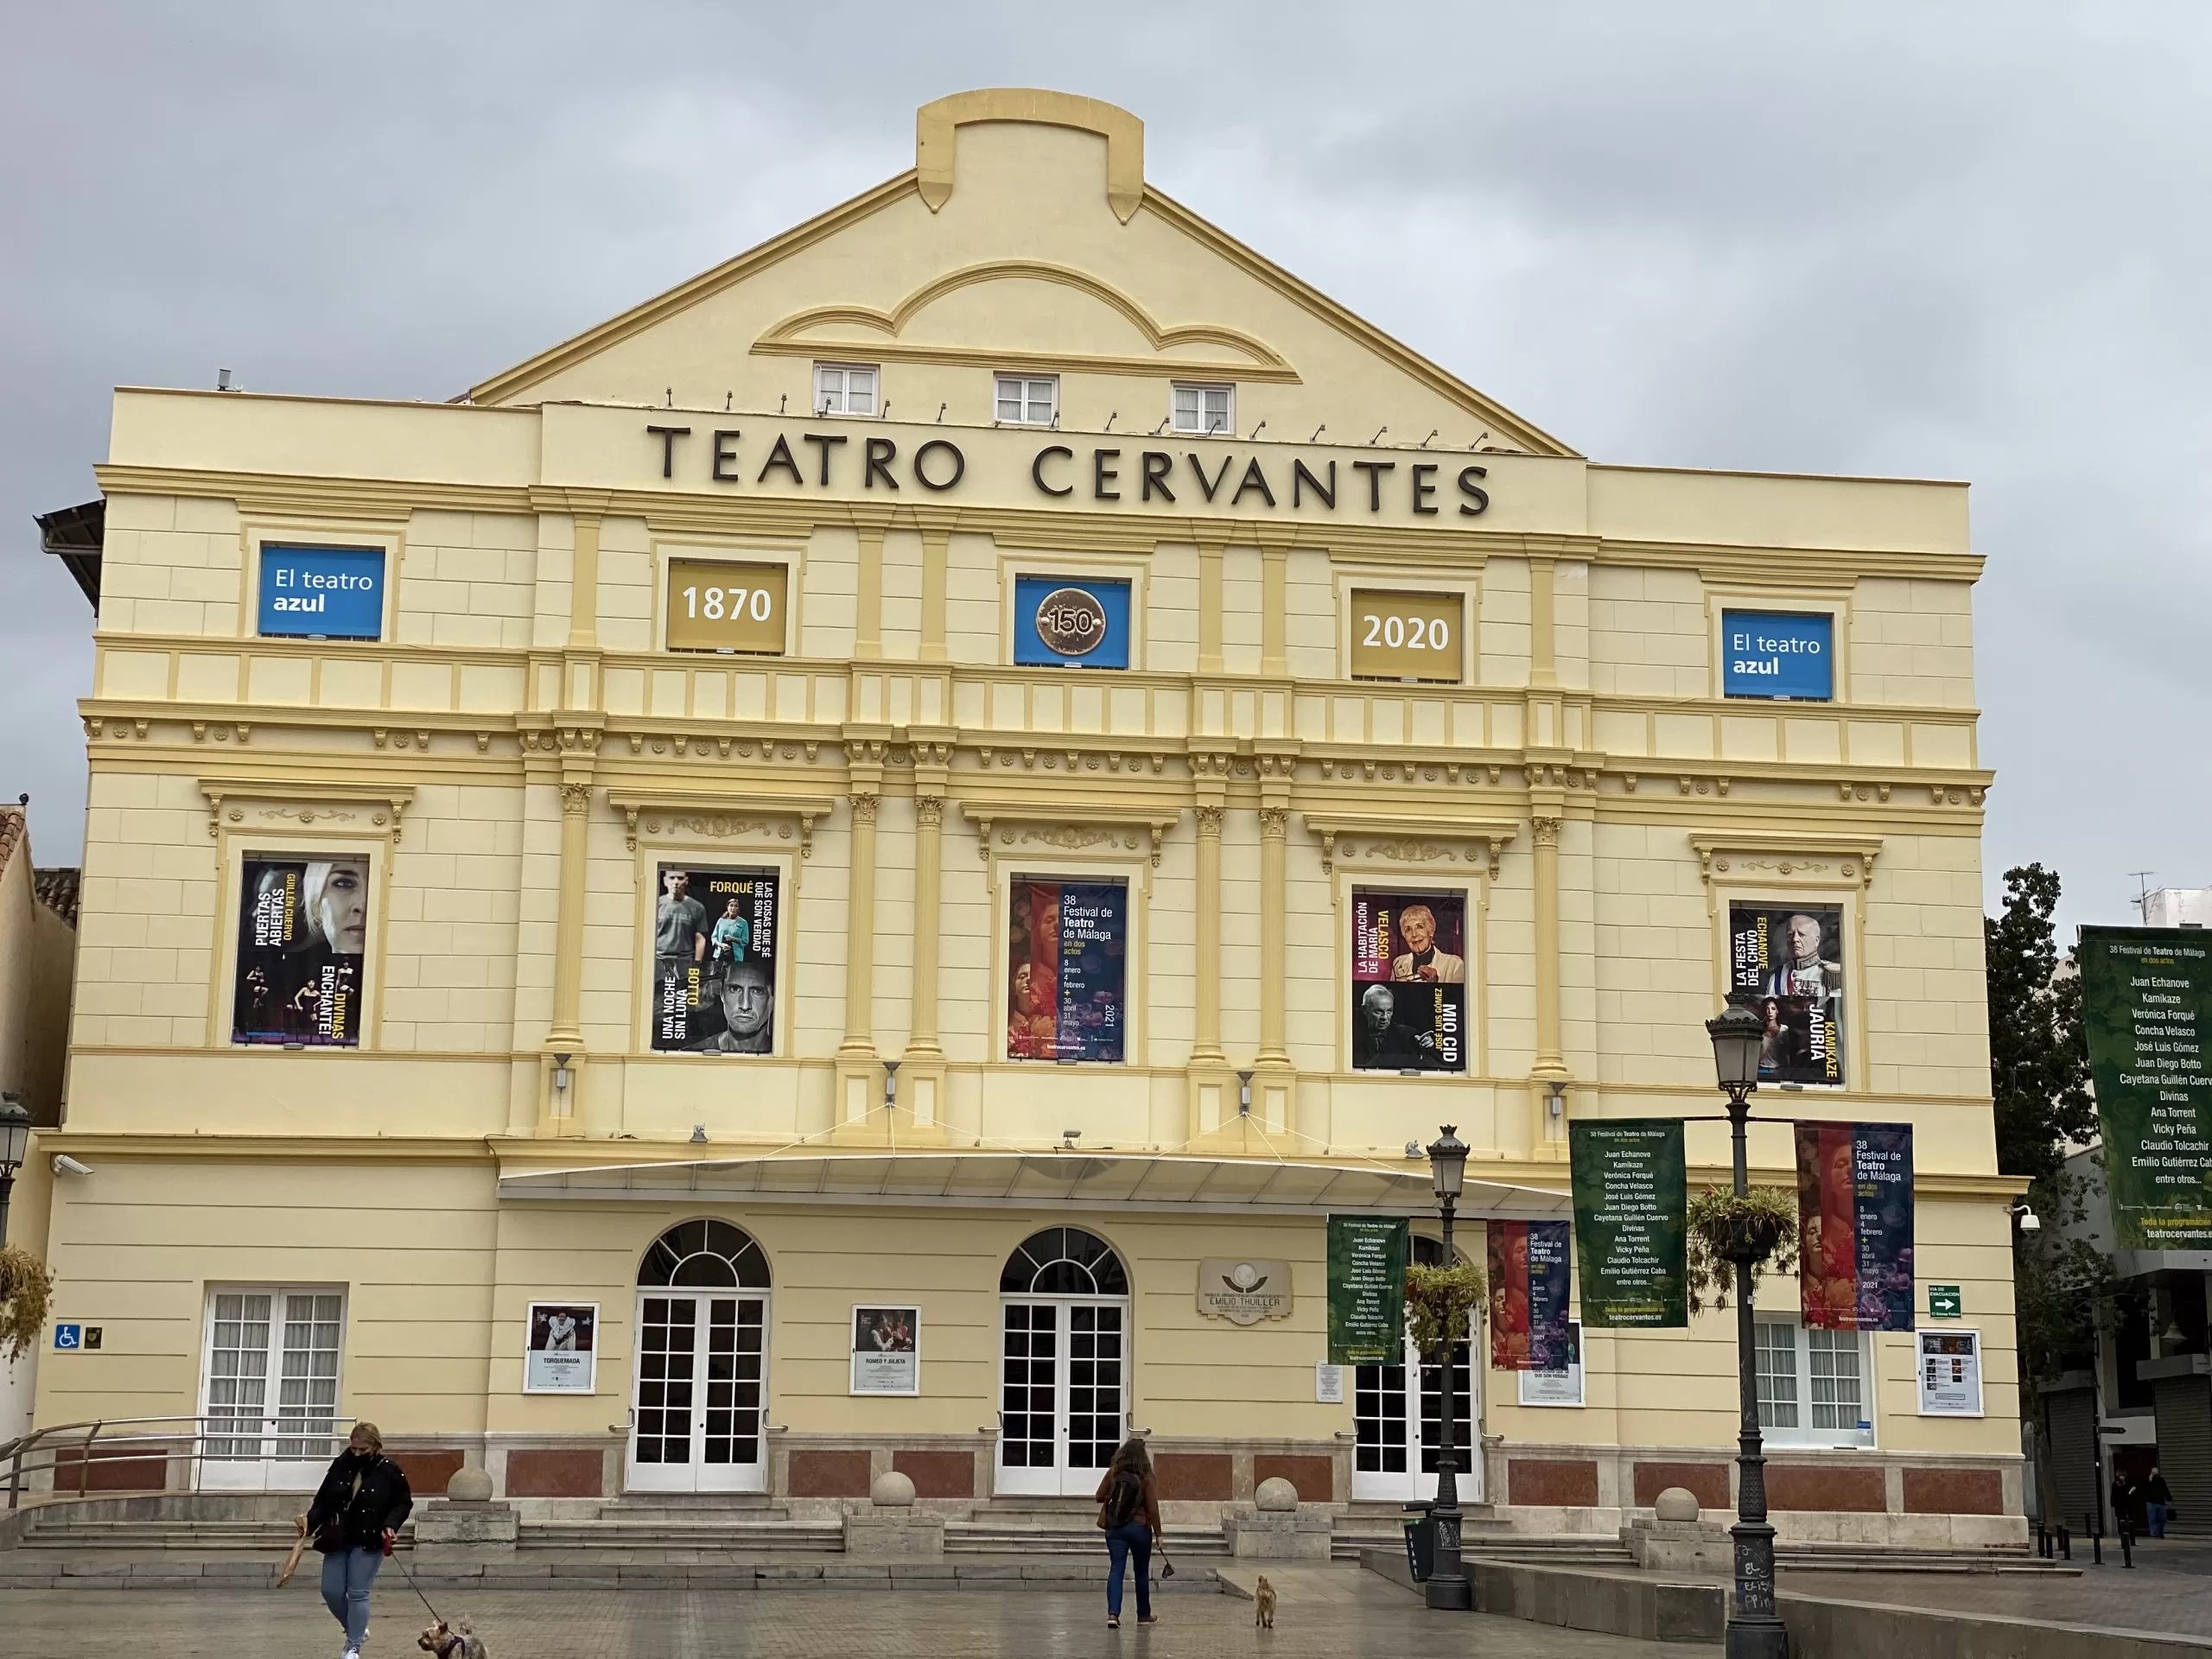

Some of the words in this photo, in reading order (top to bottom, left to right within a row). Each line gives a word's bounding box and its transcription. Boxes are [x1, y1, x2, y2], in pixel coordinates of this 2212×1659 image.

[646, 425, 965, 491] TEATRO
[1032, 445, 1490, 515] CERVANTES
[276, 569, 295, 588] El
[302, 571, 373, 590] teatro
[273, 594, 325, 613] azul
[682, 586, 772, 621] 1870
[1048, 608, 1094, 636] 150
[1362, 615, 1449, 650] 2020
[1733, 632, 1750, 652] El
[1757, 636, 1821, 653] teatro
[1732, 657, 1779, 675] azul
[286, 874, 296, 906] GUILLÉN
[709, 880, 753, 894] FORQUÉ
[755, 881, 764, 898] QUE
[765, 882, 773, 899] LAS
[754, 899, 763, 918] SON
[1065, 895, 1076, 905] 38
[255, 893, 270, 946] PUERTAS
[269, 888, 285, 947] ABIERTAS
[764, 900, 772, 928] COSAS
[1065, 906, 1097, 917] Festival
[1101, 907, 1112, 917] de
[283, 906, 294, 941] CUERVO
[1064, 917, 1094, 927] Teatro
[1357, 902, 1368, 959] HABITACIÓN
[753, 918, 762, 950] VERDAD
[763, 930, 772, 945] QUE
[1064, 929, 1075, 938] de
[1077, 929, 1111, 941] Málaga
[1369, 927, 1378, 959] MARÍA
[1377, 910, 1389, 960] VELASCO
[1758, 917, 1768, 969] ECHANOVE
[762, 947, 771, 957] SÉ
[1736, 932, 1746, 969] FIESTA
[1746, 930, 1758, 964] CHIVO
[2119, 946, 2142, 955] Festival
[2152, 947, 2173, 956] Teatro
[2183, 948, 2205, 958] Málaga
[1358, 960, 1367, 973] LA
[1369, 960, 1378, 973] DE
[1748, 966, 1759, 986] DEL
[687, 968, 700, 1005] BOTTO
[1737, 971, 1747, 986] LA
[2131, 976, 2150, 987] Juan
[2152, 977, 2190, 988] Echanove
[318, 965, 335, 1035] ENCHANTÉ!
[664, 976, 676, 1016] NOCHE
[676, 989, 687, 1020] LUNA
[1434, 988, 1443, 1014] GÓMEZ
[2143, 993, 2180, 1003] Kamikaze
[331, 993, 346, 1039] DIVINAS
[1105, 1005, 1115, 1027] 2021
[1442, 1003, 1457, 1033] MIO
[2132, 1008, 2166, 1020] Verónica
[2168, 1010, 2195, 1021] Forqué
[663, 1020, 673, 1039] UNA
[675, 1022, 685, 1039] SIN
[1809, 1004, 1825, 1061] JAURÍA
[2135, 1025, 2164, 1035] Concha
[2165, 1026, 2196, 1036] Velasco
[1443, 1036, 1458, 1063] CID
[1825, 1021, 1837, 1077] KAMIKAZE
[2134, 1041, 2153, 1052] José
[2155, 1042, 2171, 1052] Luis
[2173, 1042, 2199, 1053] Gómez
[2135, 1058, 2155, 1067] Juan
[2157, 1058, 2178, 1070] Diego
[2181, 1058, 2202, 1069] Botto
[2120, 1074, 2159, 1085] Cayetana
[2161, 1075, 2188, 1084] Guillén
[2160, 1090, 2189, 1101] Divinas
[2152, 1107, 2166, 1117] Ana
[2168, 1108, 2196, 1118] Torrent
[2153, 1123, 2174, 1135] Vicky
[2177, 1124, 2196, 1134] Peña
[1857, 1141, 1867, 1149] 38
[2141, 1140, 2173, 1150] Claudio
[2174, 1141, 2209, 1151] Tolcachir
[1857, 1150, 1888, 1160] Festival
[1891, 1151, 1901, 1160] de
[2132, 1157, 2159, 1166] Emilio
[2162, 1157, 2197, 1167] Gutiérrez
[1857, 1160, 1885, 1170] Teatro
[1858, 1171, 1867, 1179] de
[1871, 1171, 1901, 1183] Málaga
[2156, 1175, 2176, 1184] entre
[2177, 1175, 2202, 1184] otros...
